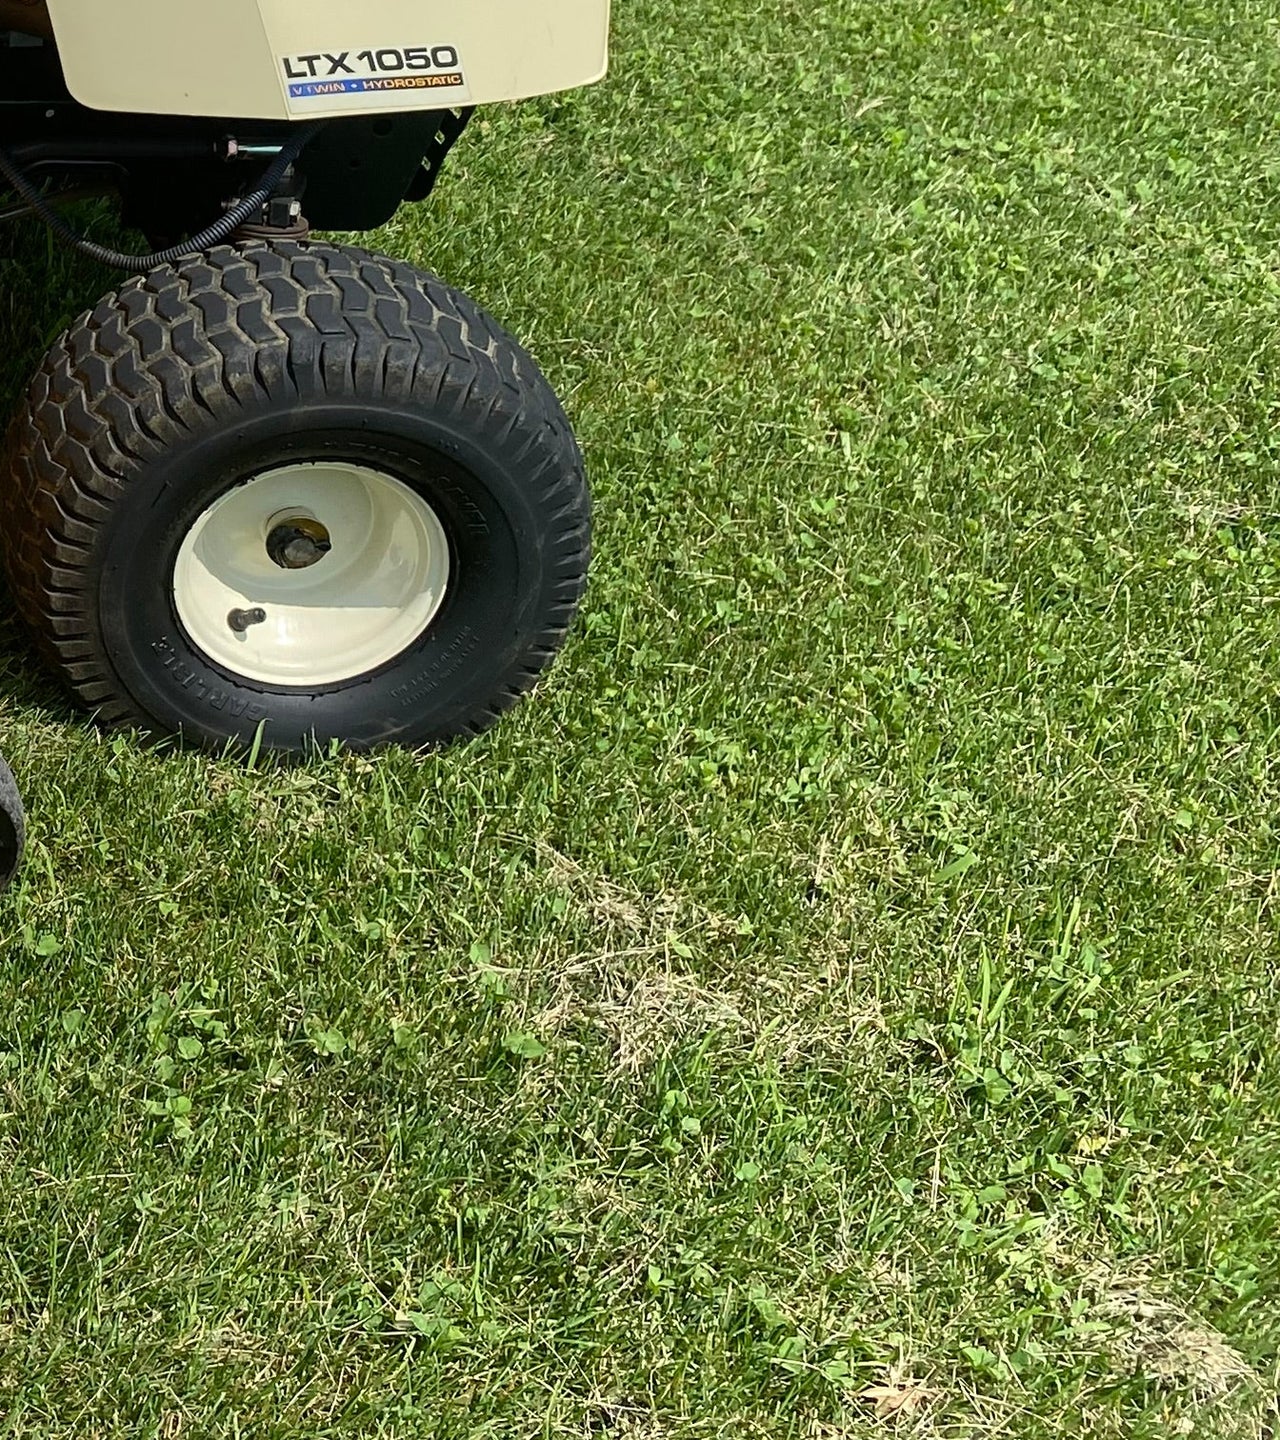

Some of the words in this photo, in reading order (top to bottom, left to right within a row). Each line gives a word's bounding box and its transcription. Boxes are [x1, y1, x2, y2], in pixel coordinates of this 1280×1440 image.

[282, 51, 356, 79] LTX
[356, 45, 459, 72] 1050
[362, 74, 462, 90] HYDROSTATIC
